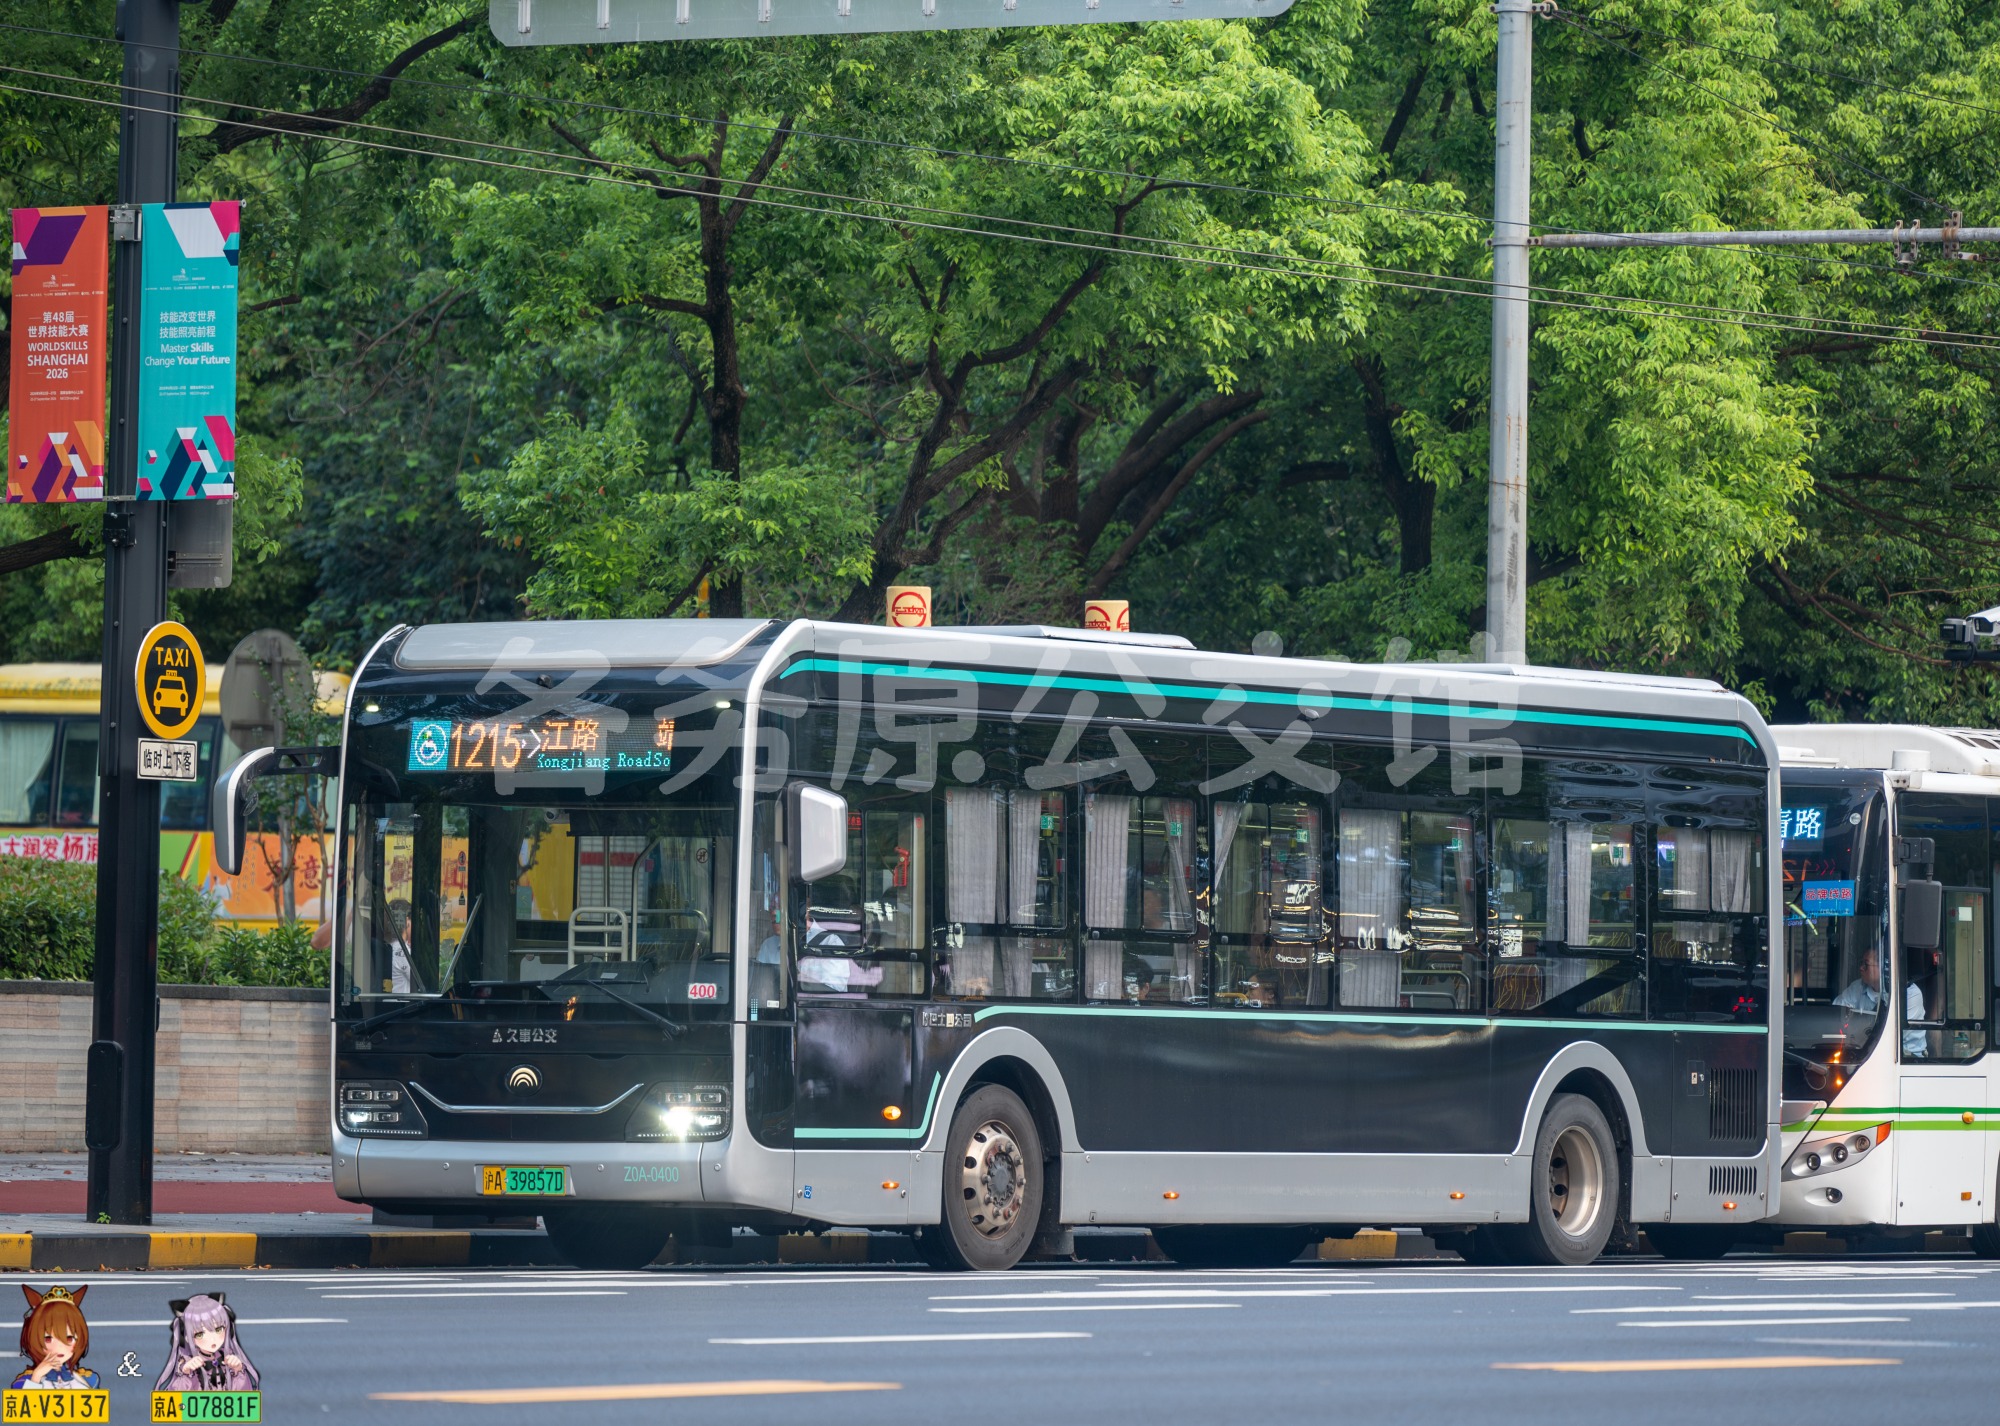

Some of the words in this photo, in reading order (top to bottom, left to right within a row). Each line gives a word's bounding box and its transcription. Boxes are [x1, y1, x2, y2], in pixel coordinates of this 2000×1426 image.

[43, 311, 75, 323] 第48届
[159, 310, 217, 324] 技能改变世界
[27, 324, 89, 338] 世界技能大赛
[159, 325, 217, 339] 技能照亮前程
[28, 341, 88, 352] WORLDSKILLS
[160, 343, 189, 353] Master
[190, 342, 214, 352] Skills
[27, 353, 88, 367] SHANGHAI
[144, 356, 176, 368] Change
[177, 355, 199, 365] Your
[200, 355, 231, 365] Future
[46, 368, 69, 379] 2026
[155, 646, 189, 667] TAXI
[451, 722, 523, 768] 1215
[143, 748, 192, 771] 临时上下客
[1805, 888, 1852, 901] 品牌线路
[690, 985, 716, 998] 400
[506, 1028, 558, 1043] 久事公交
